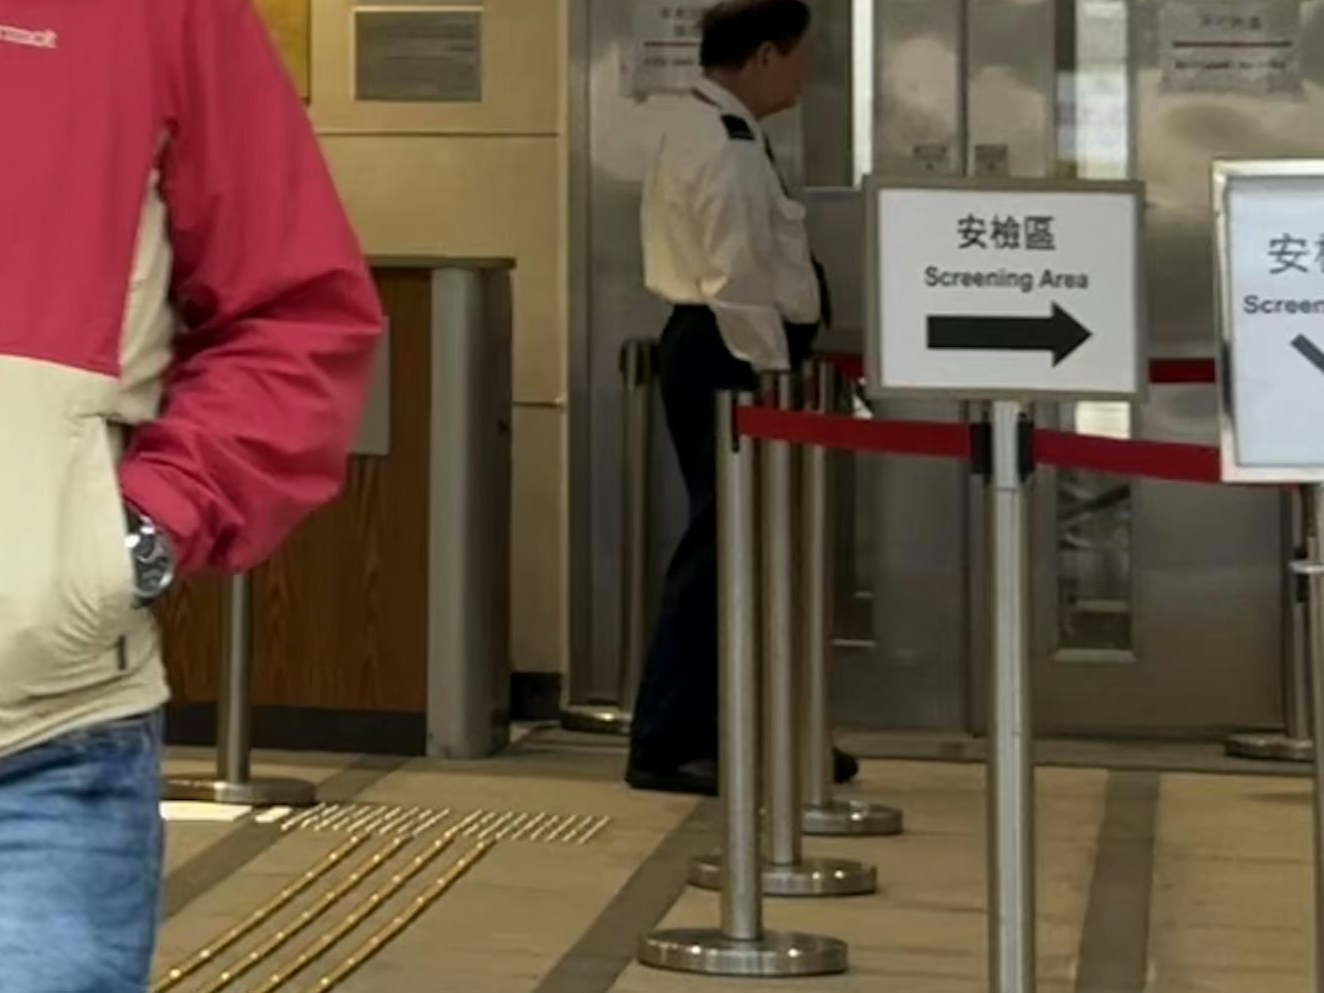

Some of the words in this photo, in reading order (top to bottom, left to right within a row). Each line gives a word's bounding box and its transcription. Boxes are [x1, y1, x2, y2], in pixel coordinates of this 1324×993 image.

[957, 213, 1057, 250] 安檢區
[1267, 233, 1324, 274] 安
[924, 265, 1033, 293] Screening
[1039, 269, 1089, 289] Area
